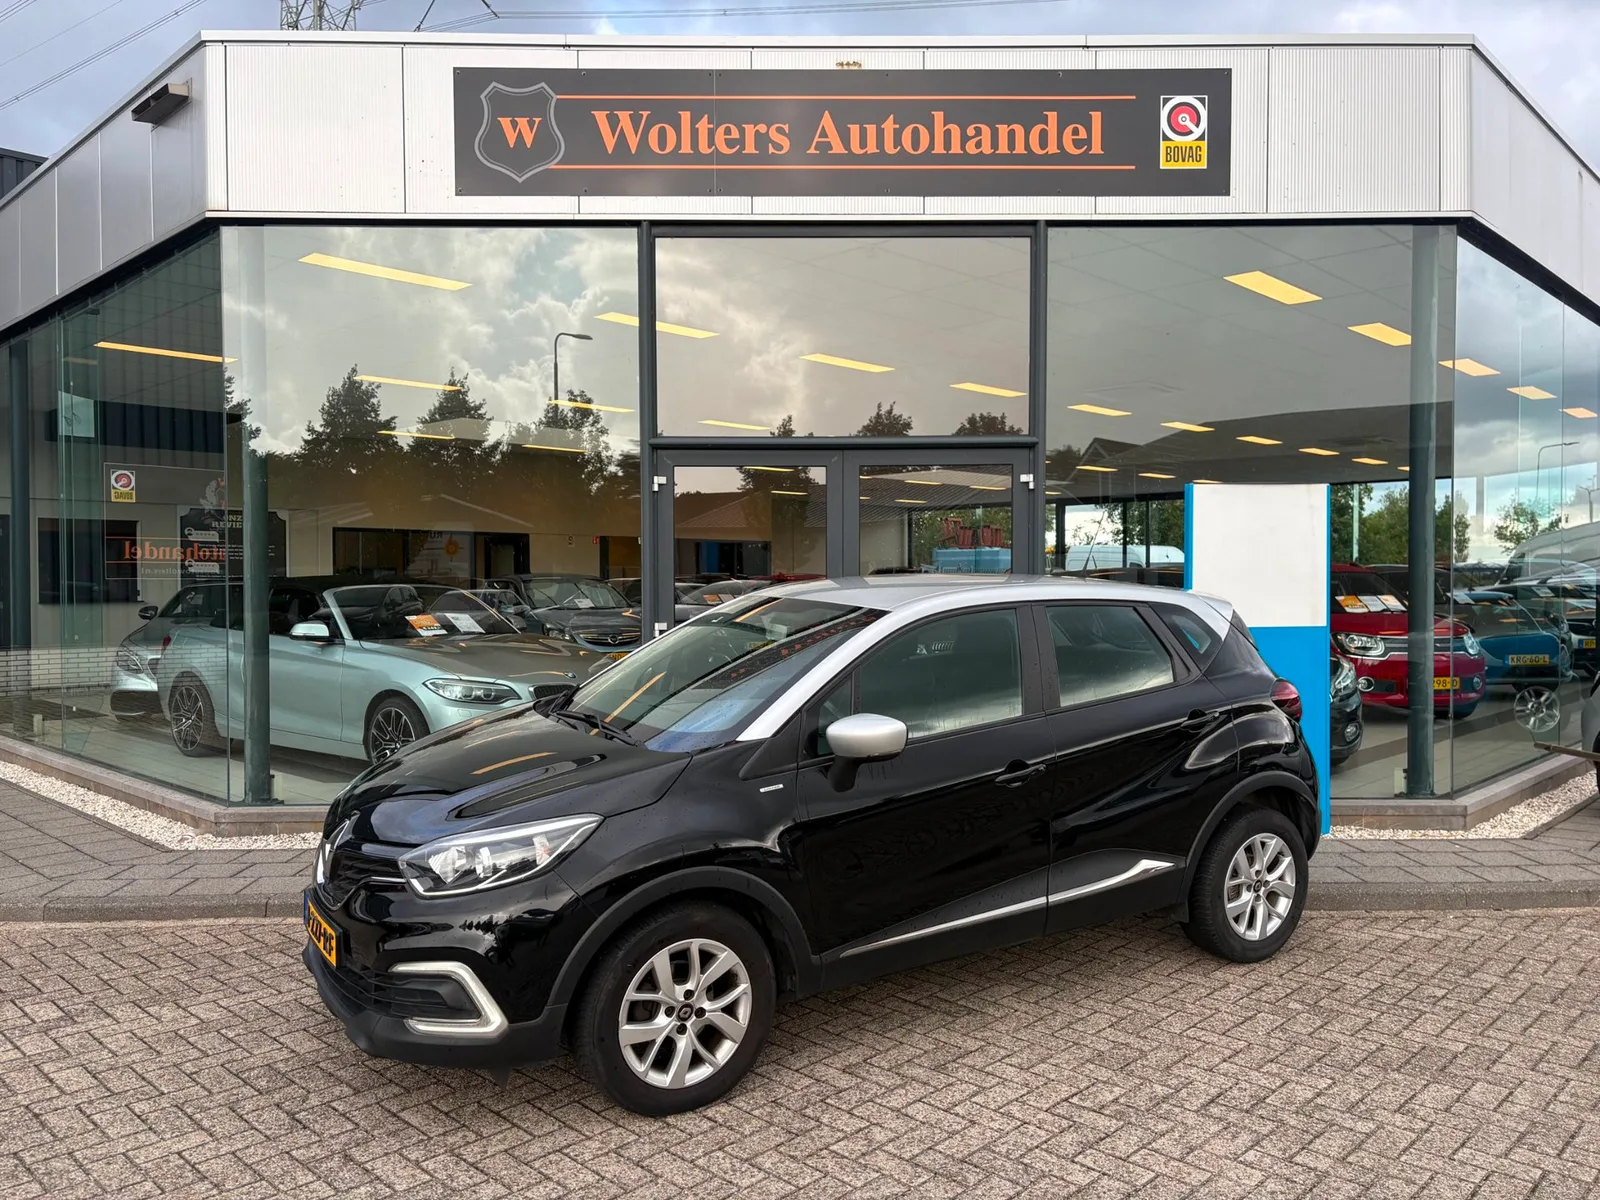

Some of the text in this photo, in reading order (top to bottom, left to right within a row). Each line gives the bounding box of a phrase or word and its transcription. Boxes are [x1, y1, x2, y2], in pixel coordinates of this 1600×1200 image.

[497, 117, 542, 148] W
[590, 110, 1105, 155] Wolters Autohandel
[1165, 145, 1202, 163] BOVAG
[211, 521, 243, 529] REVIE
[1510, 655, 1548, 664] KRG-60-L
